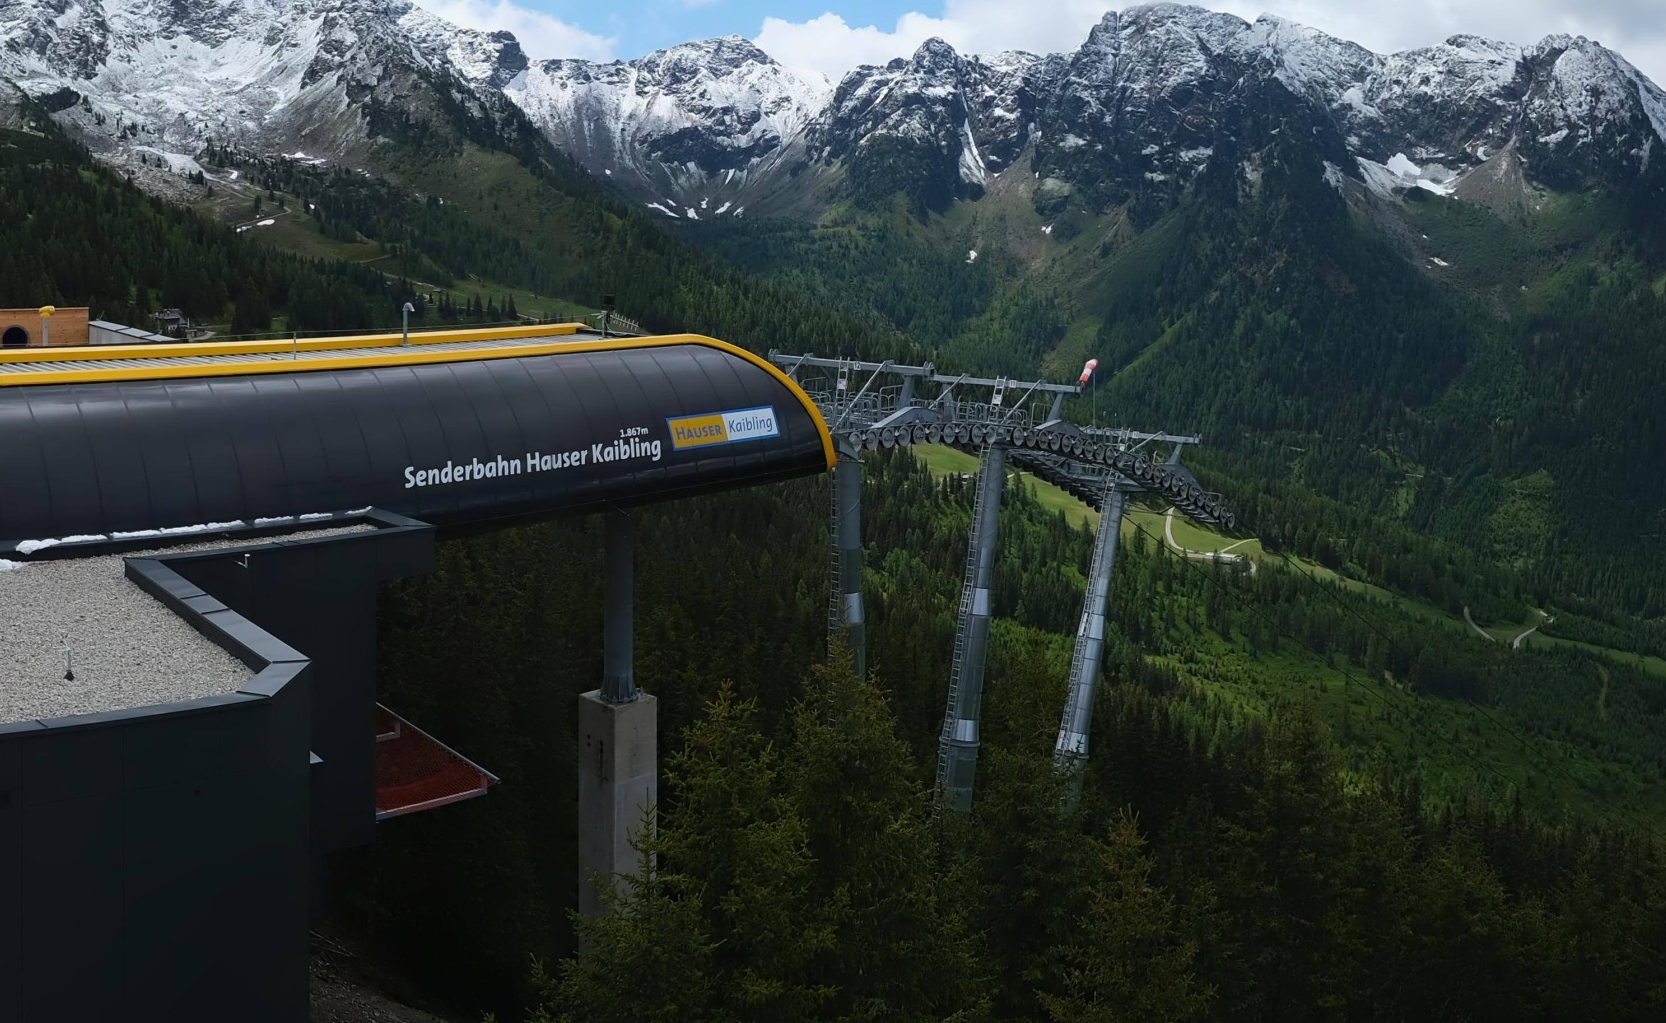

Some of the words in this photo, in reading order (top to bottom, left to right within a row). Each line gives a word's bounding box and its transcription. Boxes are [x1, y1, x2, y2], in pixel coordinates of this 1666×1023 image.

[620, 426, 648, 438] 1.867m
[675, 423, 722, 440] HAUSER
[729, 416, 773, 434] Kaibling
[404, 454, 522, 489] Senderbahn
[526, 448, 588, 473] Hauser
[592, 438, 662, 464] Kaibling
